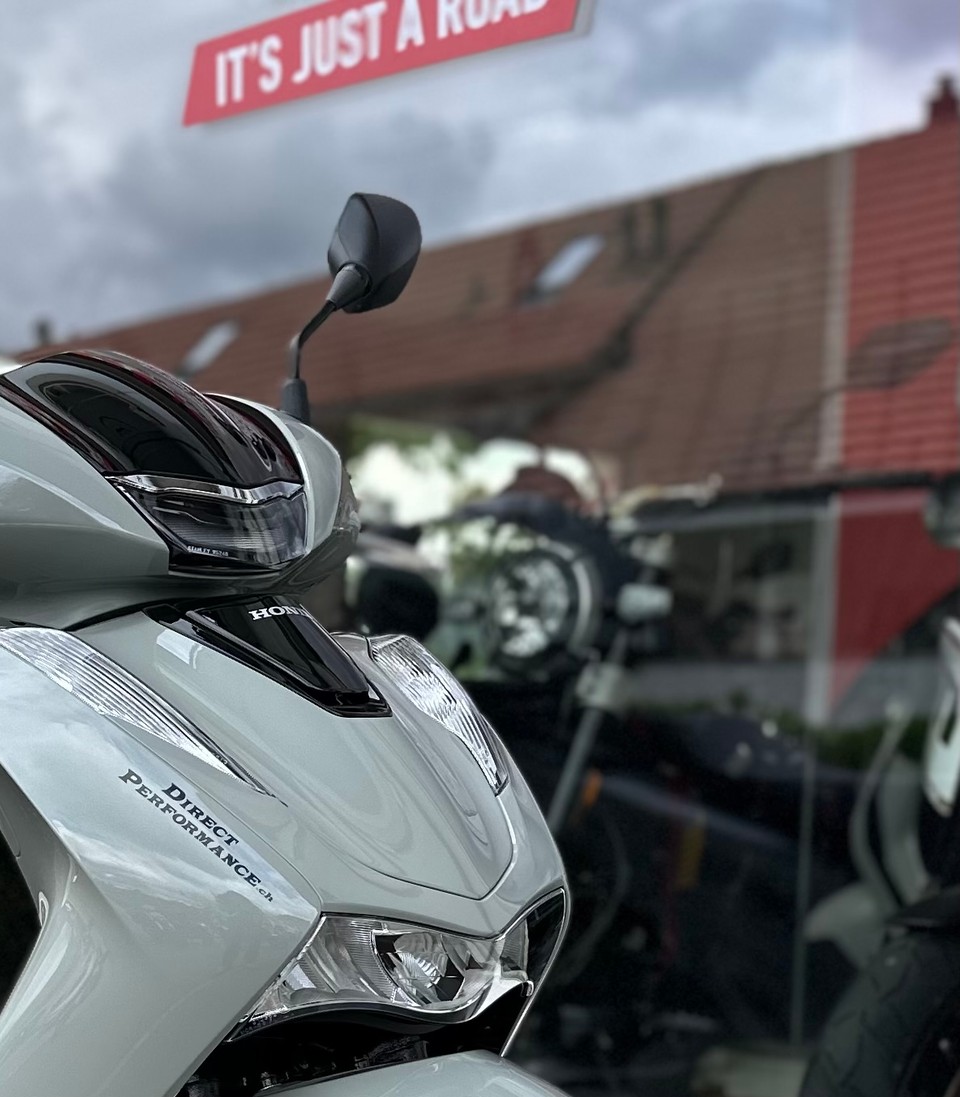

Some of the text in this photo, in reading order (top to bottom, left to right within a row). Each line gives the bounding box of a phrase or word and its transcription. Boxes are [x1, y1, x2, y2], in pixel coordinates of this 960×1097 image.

[214, 34, 282, 107] IT'S
[291, 1, 388, 85] JUST
[396, 0, 424, 53] A
[161, 782, 239, 847] DIRECT
